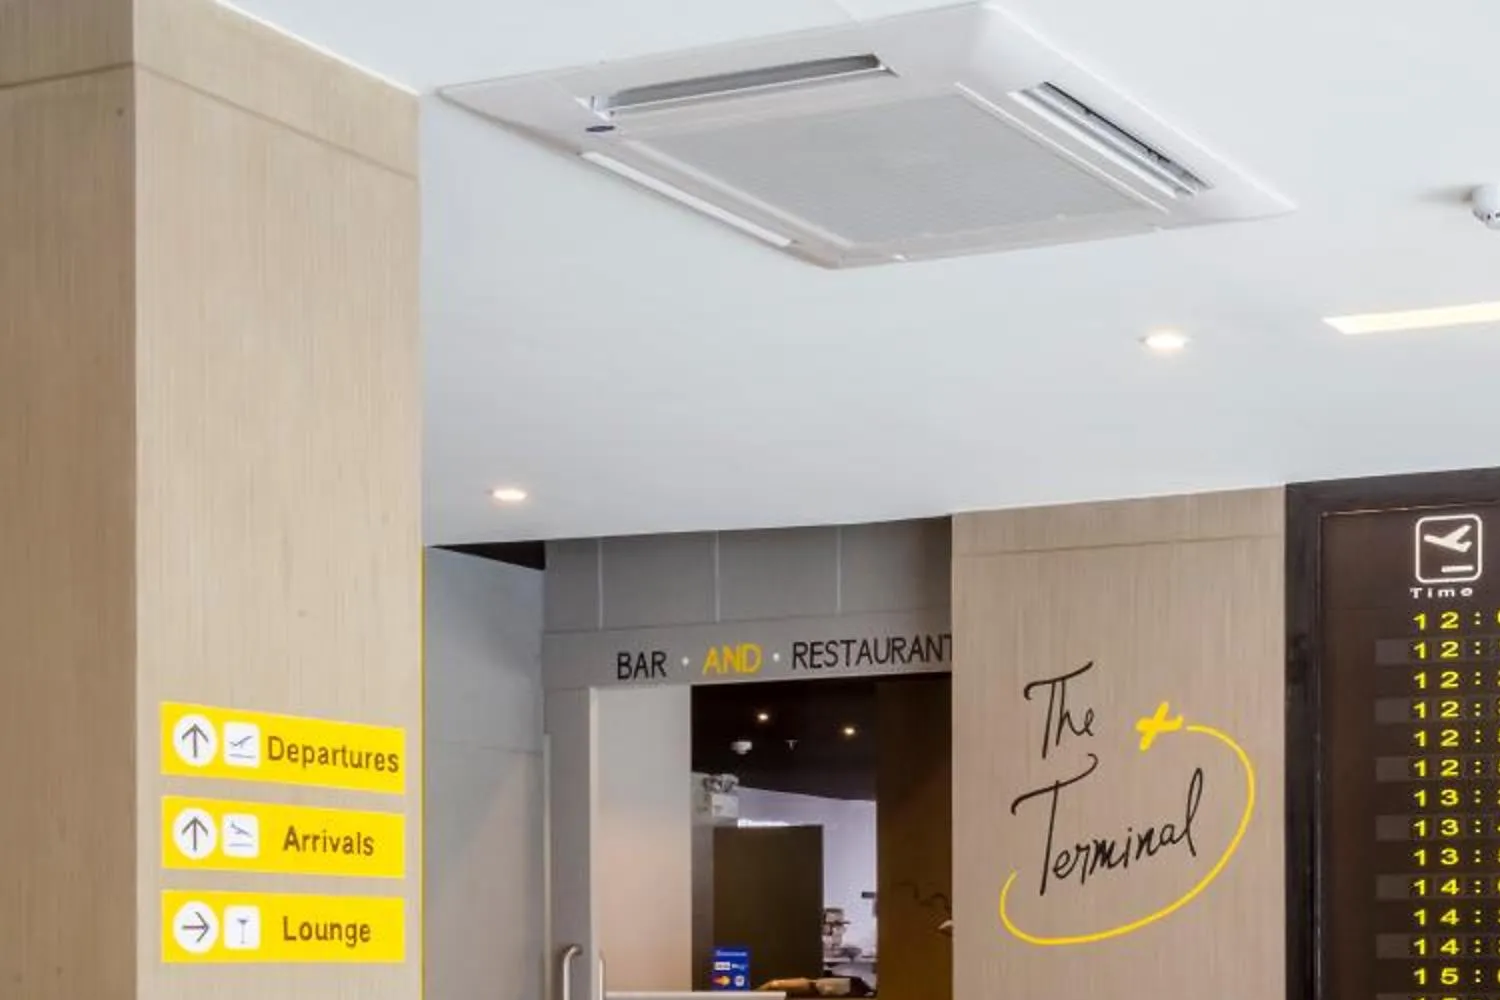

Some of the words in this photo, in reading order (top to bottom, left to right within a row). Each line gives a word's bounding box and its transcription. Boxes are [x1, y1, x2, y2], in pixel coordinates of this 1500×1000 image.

[1409, 585, 1474, 599] Time
[617, 650, 668, 680] BAR
[703, 642, 764, 675] AND
[1023, 661, 1097, 759] The
[267, 735, 400, 774] Departures
[282, 825, 375, 857] Arrivals
[1010, 753, 1203, 896] Terminal
[282, 915, 371, 949] Lounge
